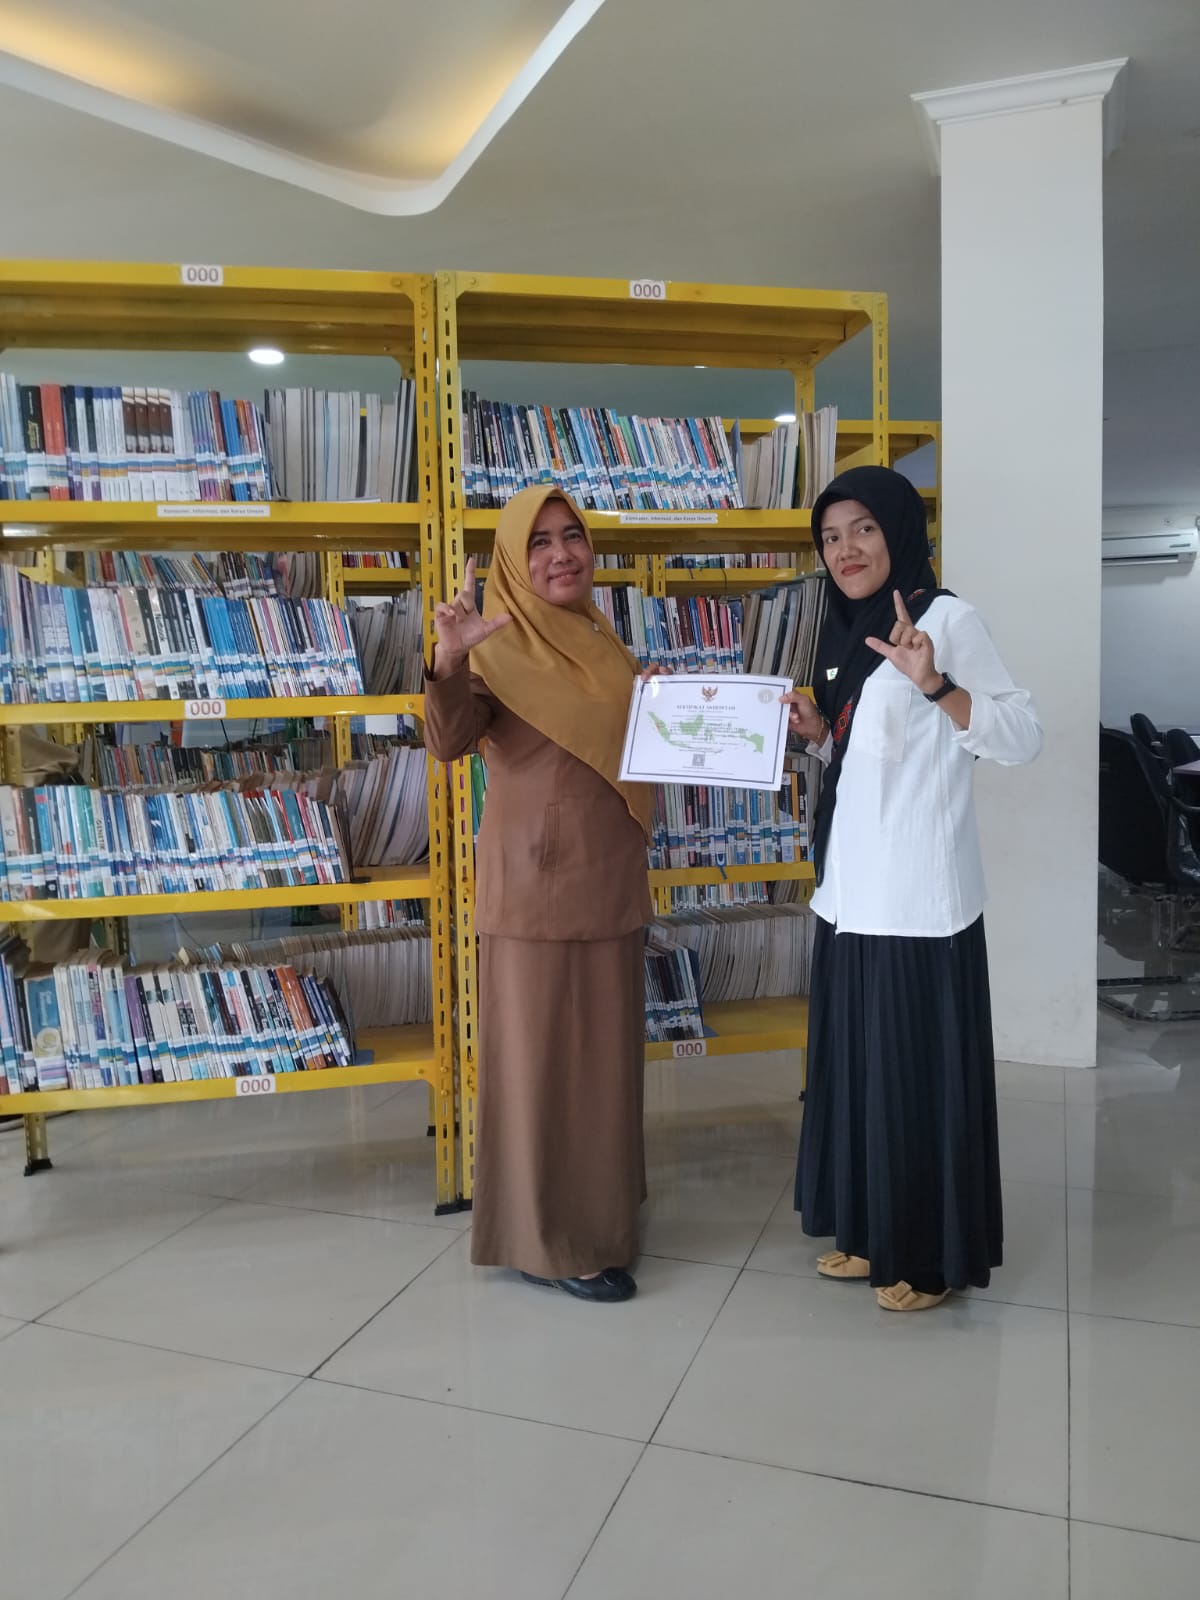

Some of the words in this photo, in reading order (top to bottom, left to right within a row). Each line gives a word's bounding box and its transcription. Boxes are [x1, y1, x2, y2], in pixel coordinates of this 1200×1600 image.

[187, 267, 219, 282] 000
[633, 283, 662, 298] 000
[190, 701, 222, 716] 000
[676, 1042, 703, 1057] 000
[240, 1078, 271, 1093] 000
